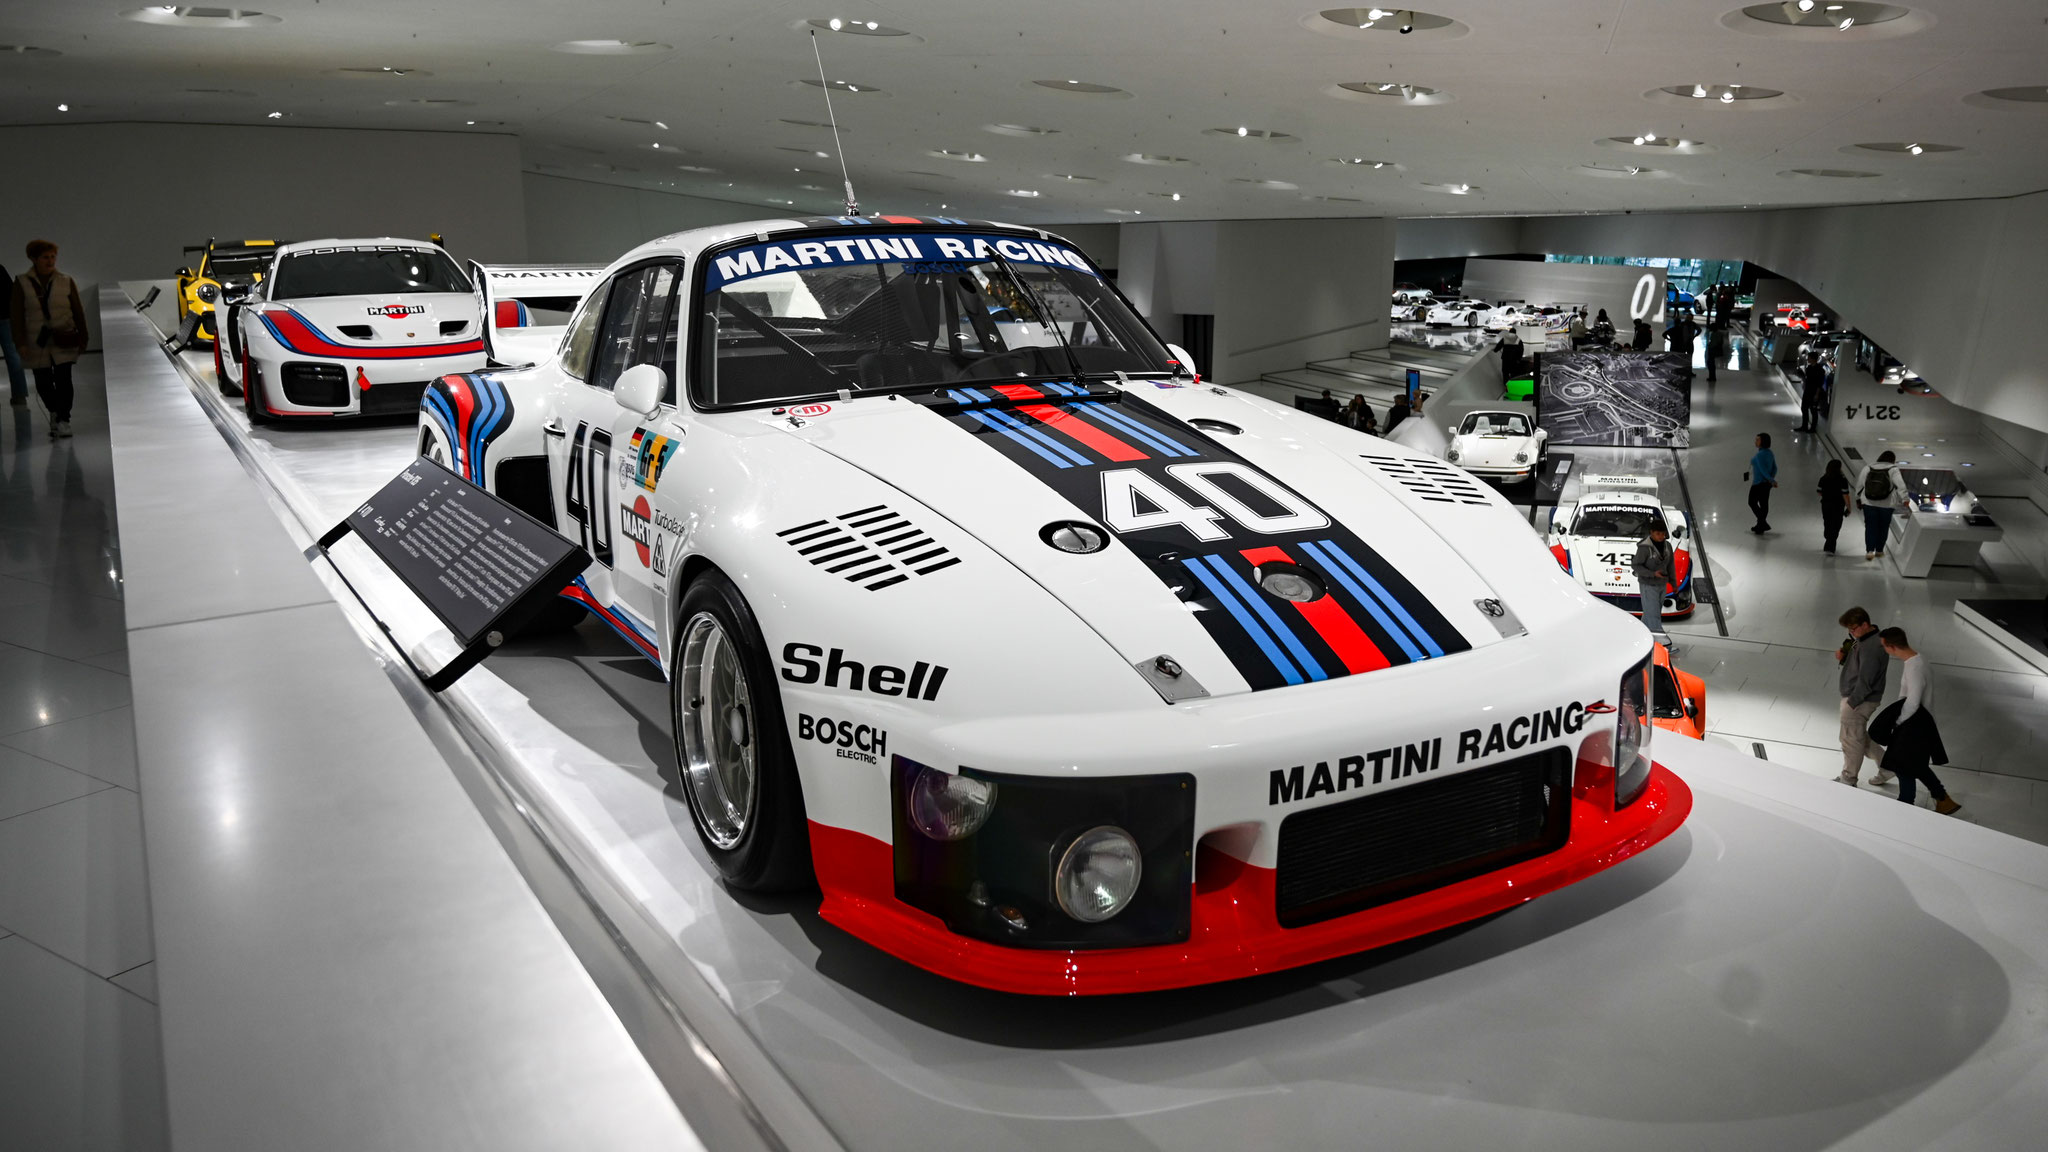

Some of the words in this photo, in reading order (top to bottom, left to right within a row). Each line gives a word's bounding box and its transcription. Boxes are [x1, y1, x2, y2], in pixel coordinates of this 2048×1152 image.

[293, 246, 437, 259] PORSCHE
[715, 237, 924, 281] MARTINI
[934, 237, 1095, 274] RACING
[369, 305, 424, 315] MARTINI
[1845, 403, 1901, 420] 321,4
[565, 419, 615, 572] 40
[1100, 461, 1333, 543] 40
[1585, 505, 1617, 513] MARTINI
[1617, 506, 1654, 514] PORSCHE
[1600, 552, 1635, 566] 43
[781, 642, 949, 701] Shell
[798, 713, 887, 758] BOSCH
[836, 748, 877, 765] ELECTRIC
[1269, 737, 1442, 806] MARTINI
[1456, 701, 1586, 764] RACING
